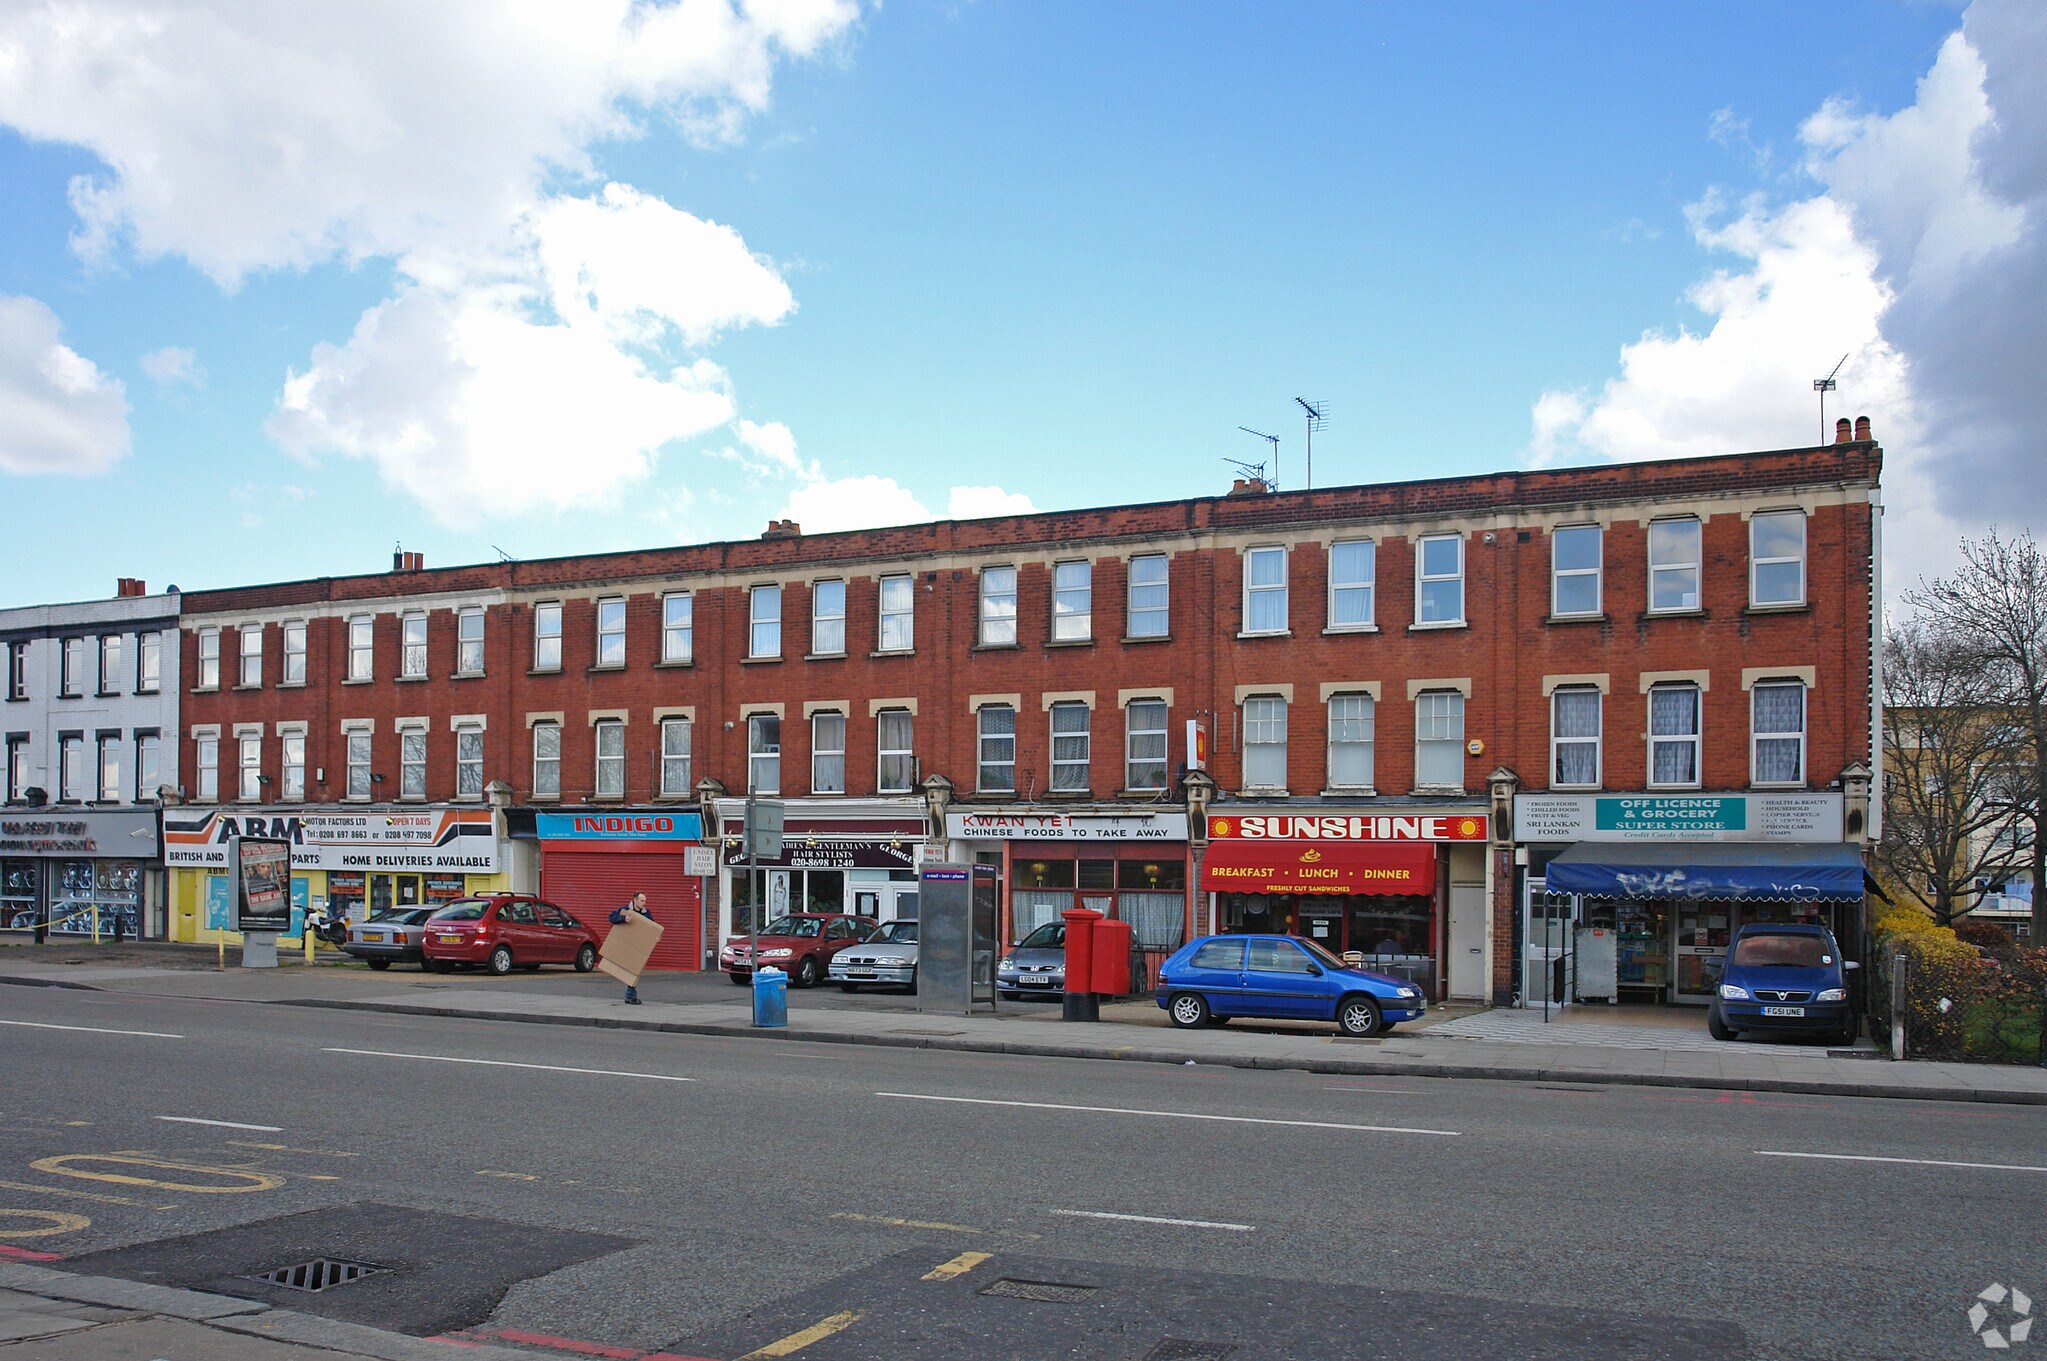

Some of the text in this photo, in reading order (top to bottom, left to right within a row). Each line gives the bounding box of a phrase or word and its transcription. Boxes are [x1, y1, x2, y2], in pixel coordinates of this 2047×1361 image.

[1619, 799, 1721, 808] OFF LICENCE
[1624, 809, 1718, 818] & GROCERY
[305, 817, 367, 827] MOTOR FACTORS LTD
[393, 817, 432, 827] OPEN 7 DAYS
[573, 816, 674, 834] INDIGO
[962, 815, 1072, 827] KWAN YET
[1543, 820, 1581, 828] LANKAN
[1615, 821, 1726, 829] SUPER STORE
[963, 828, 1169, 838] CHINESE FOODS TO TAKE AWAY
[1240, 816, 1450, 840] SUNSHINE
[337, 830, 349, 839] 697
[351, 831, 367, 839] 8663
[384, 830, 401, 839] 0208
[416, 831, 432, 840] 7098
[1677, 832, 1715, 840] Accepted
[781, 841, 803, 849] ADIES
[169, 852, 224, 862] BRITISH AND
[291, 853, 320, 865] PARTS
[792, 850, 853, 858] HAIR STYLISTS
[342, 854, 491, 868] HOME DELIVERIES AVAILABLE
[791, 857, 854, 867] 020-8698 1240
[1212, 866, 1275, 878] BREAKFAST
[1298, 867, 1339, 879] LUNCH
[1364, 869, 1411, 880] DINNER
[1266, 884, 1293, 892] FRESHLY
[1308, 885, 1350, 893] SANDWICHES
[1786, 1008, 1802, 1016] UNE
